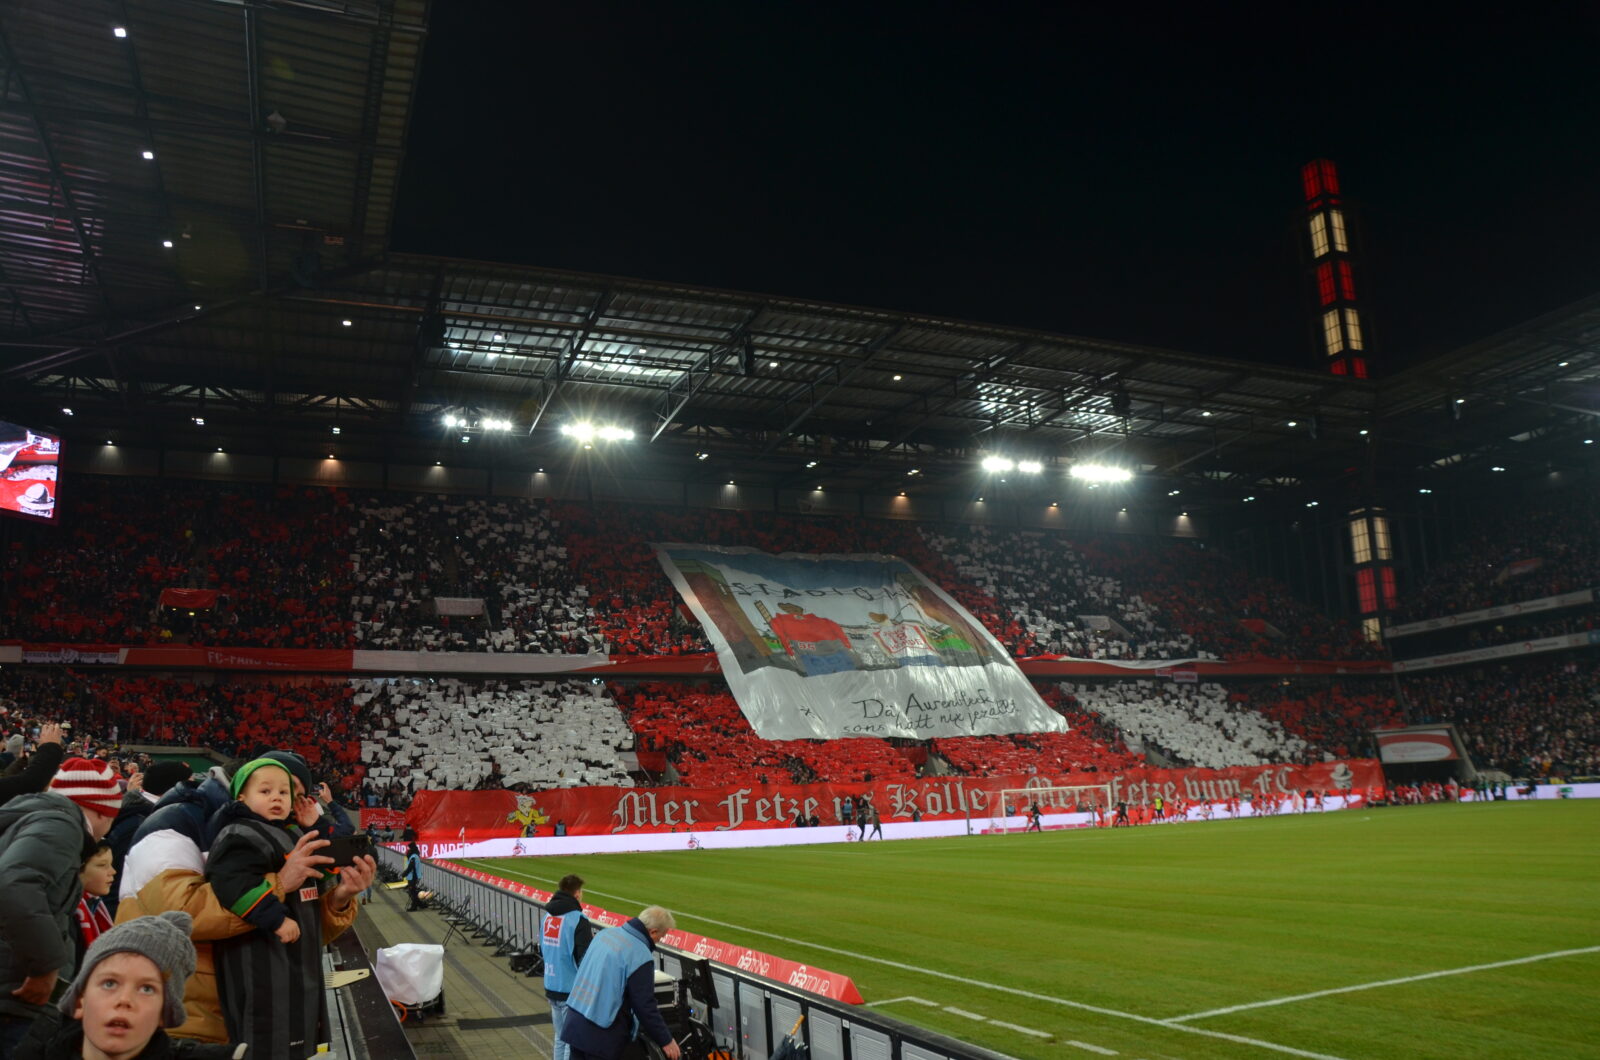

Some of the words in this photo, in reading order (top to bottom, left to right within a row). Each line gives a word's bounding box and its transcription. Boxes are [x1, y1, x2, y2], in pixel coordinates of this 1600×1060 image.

[612, 790, 700, 834] Mer
[715, 787, 820, 831] Fetze
[886, 781, 989, 819] Kölle
[1021, 775, 1085, 812] Mer
[1103, 775, 1177, 808] Fetze
[1252, 766, 1296, 795] FC
[788, 968, 830, 996] DERTOUR
